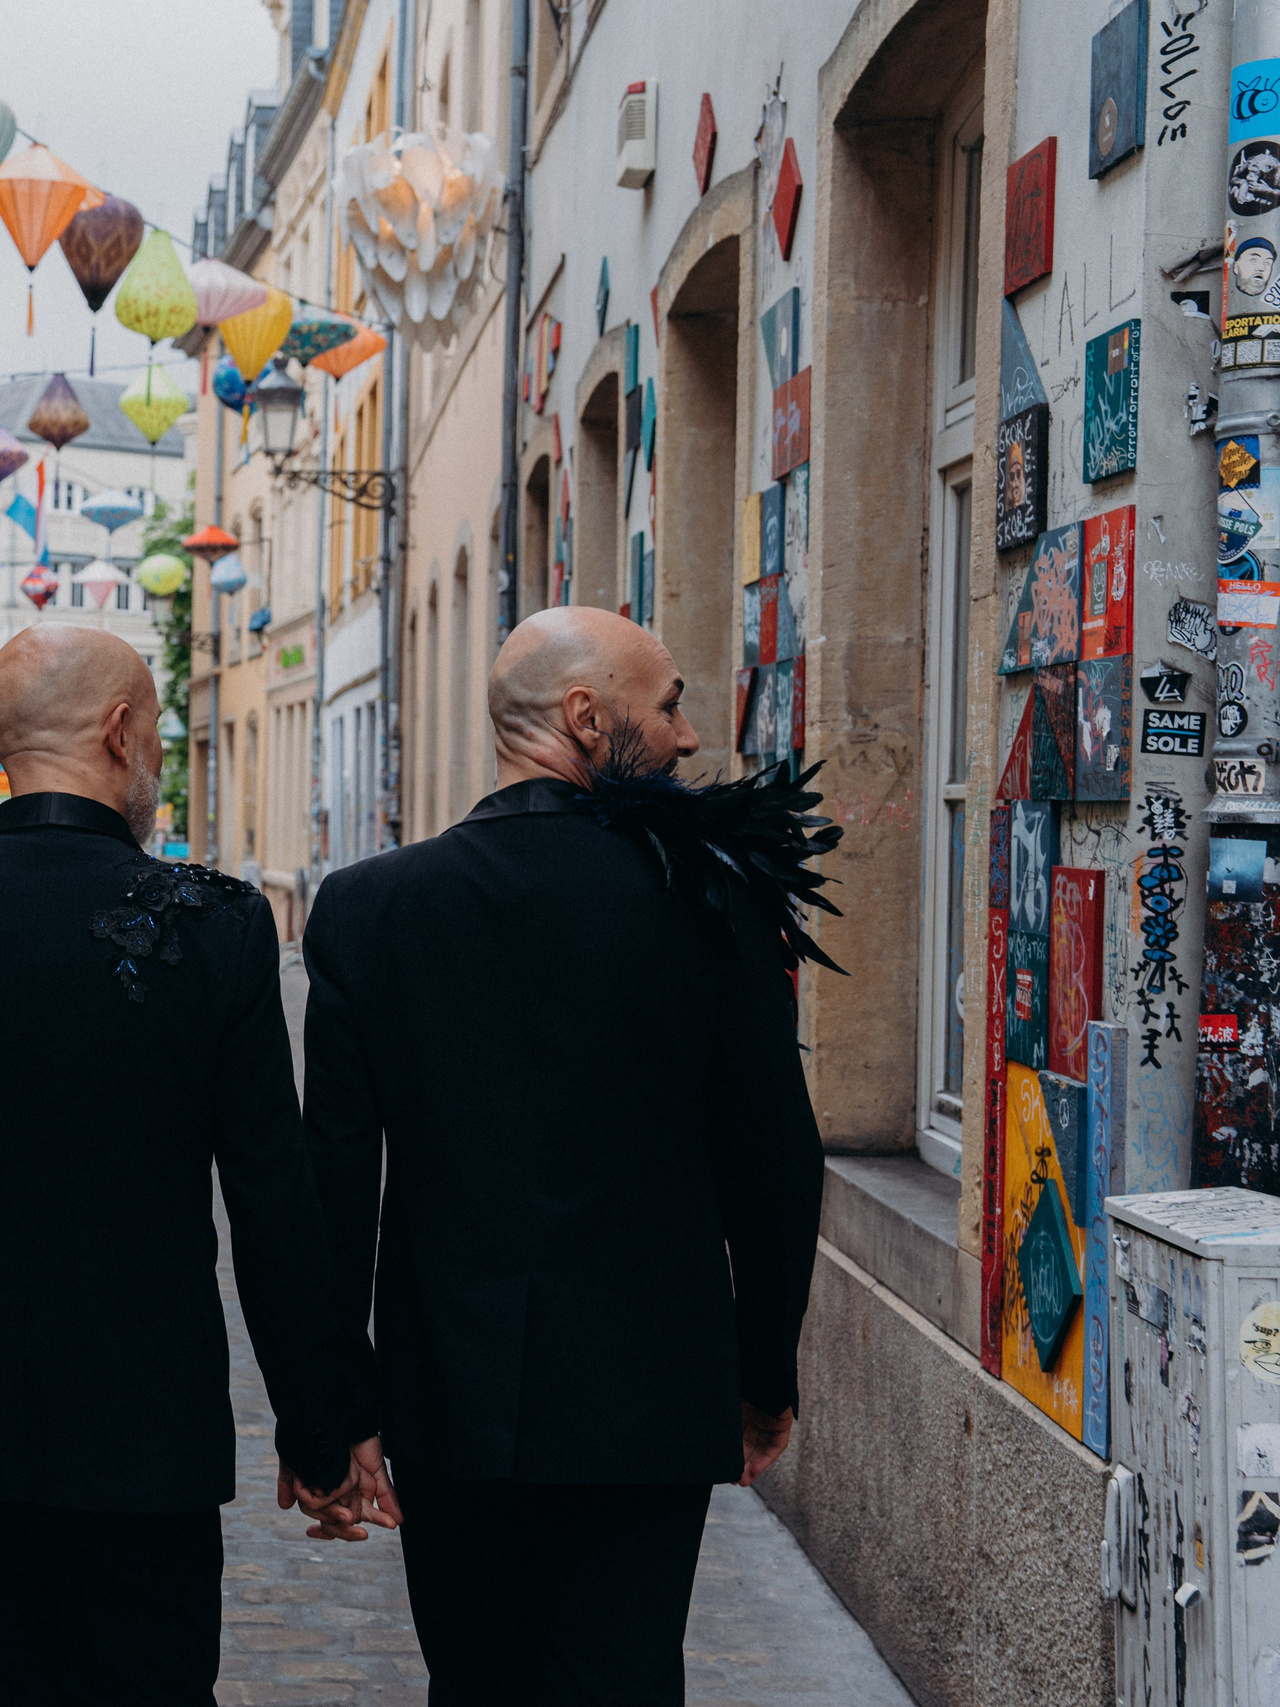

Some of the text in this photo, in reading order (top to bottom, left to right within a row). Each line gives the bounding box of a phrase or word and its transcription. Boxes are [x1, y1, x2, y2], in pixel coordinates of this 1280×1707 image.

[1225, 315, 1280, 330] EPORTATIO
[1233, 521, 1256, 536] POLS
[1229, 581, 1261, 592] HELLO
[1148, 712, 1201, 731] SAME
[1146, 735, 1200, 754] SOLE
